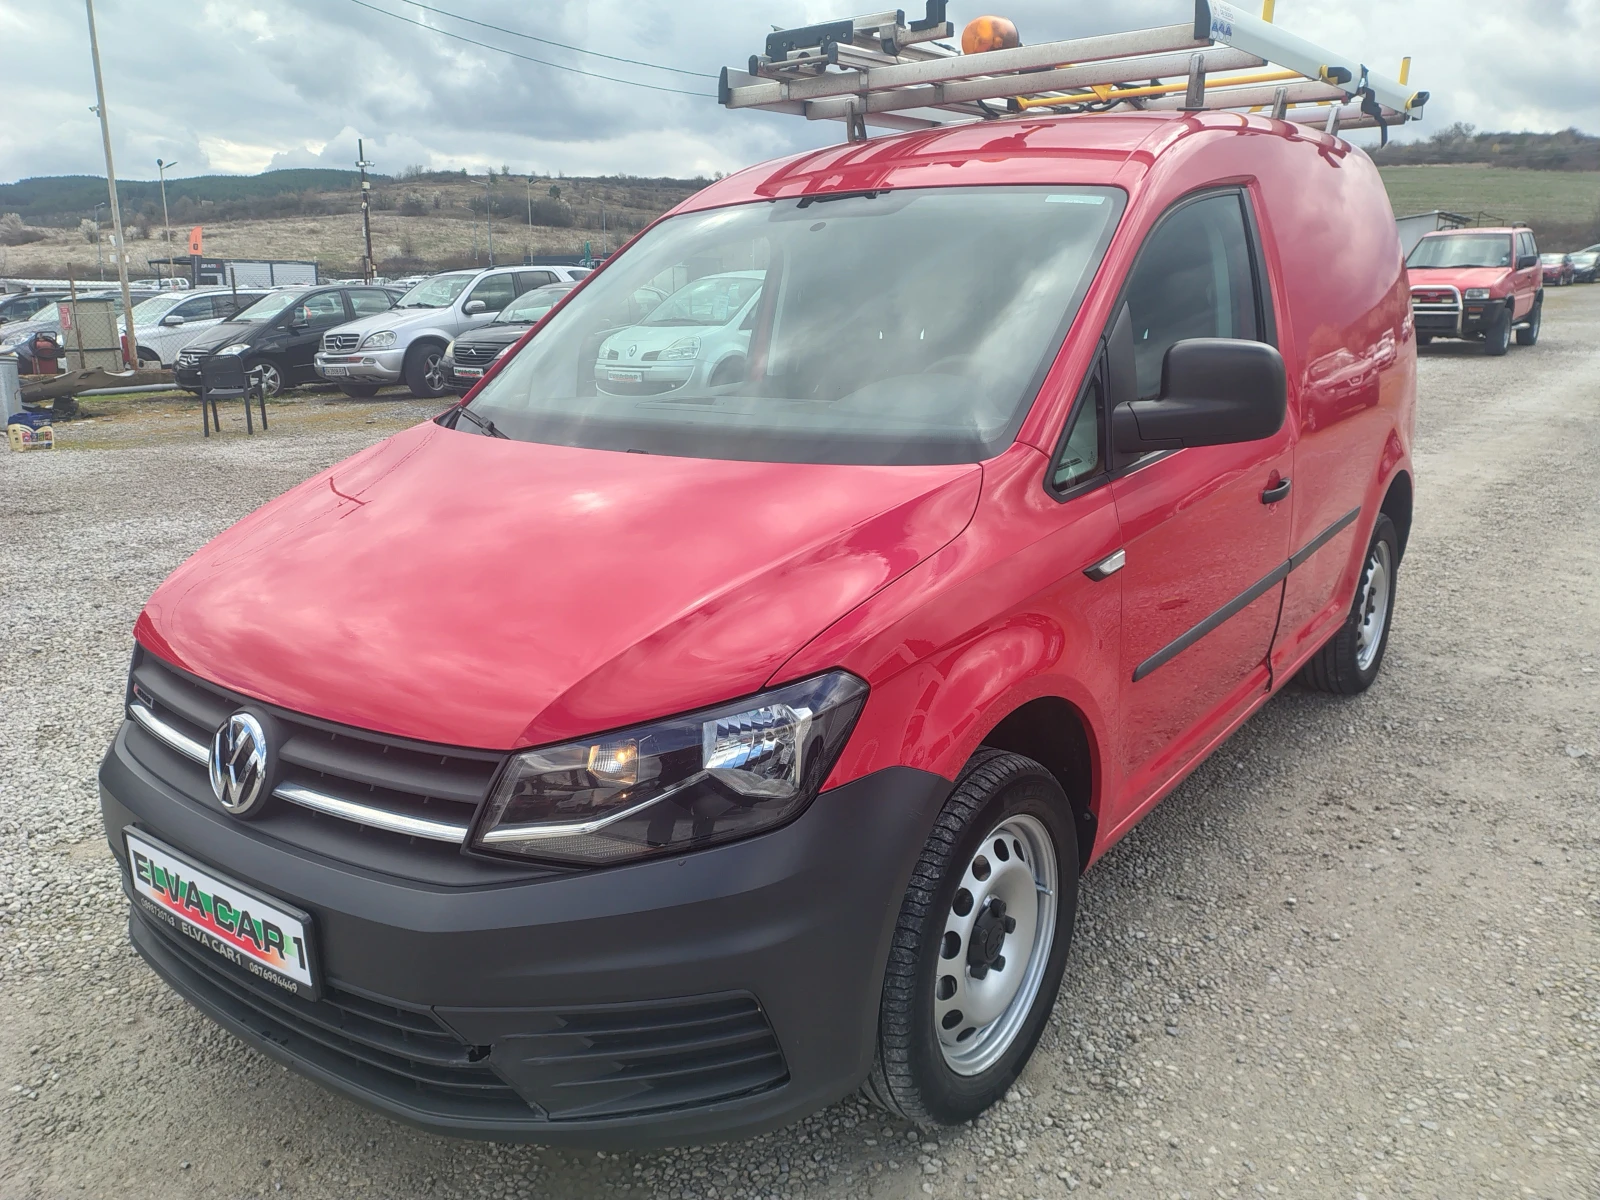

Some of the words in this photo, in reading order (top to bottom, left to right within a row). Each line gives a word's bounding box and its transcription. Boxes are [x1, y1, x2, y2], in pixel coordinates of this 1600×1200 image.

[132, 849, 207, 919] ELVA
[212, 893, 285, 960] CAR
[293, 936, 307, 970] 1
[182, 924, 210, 947] ELVA
